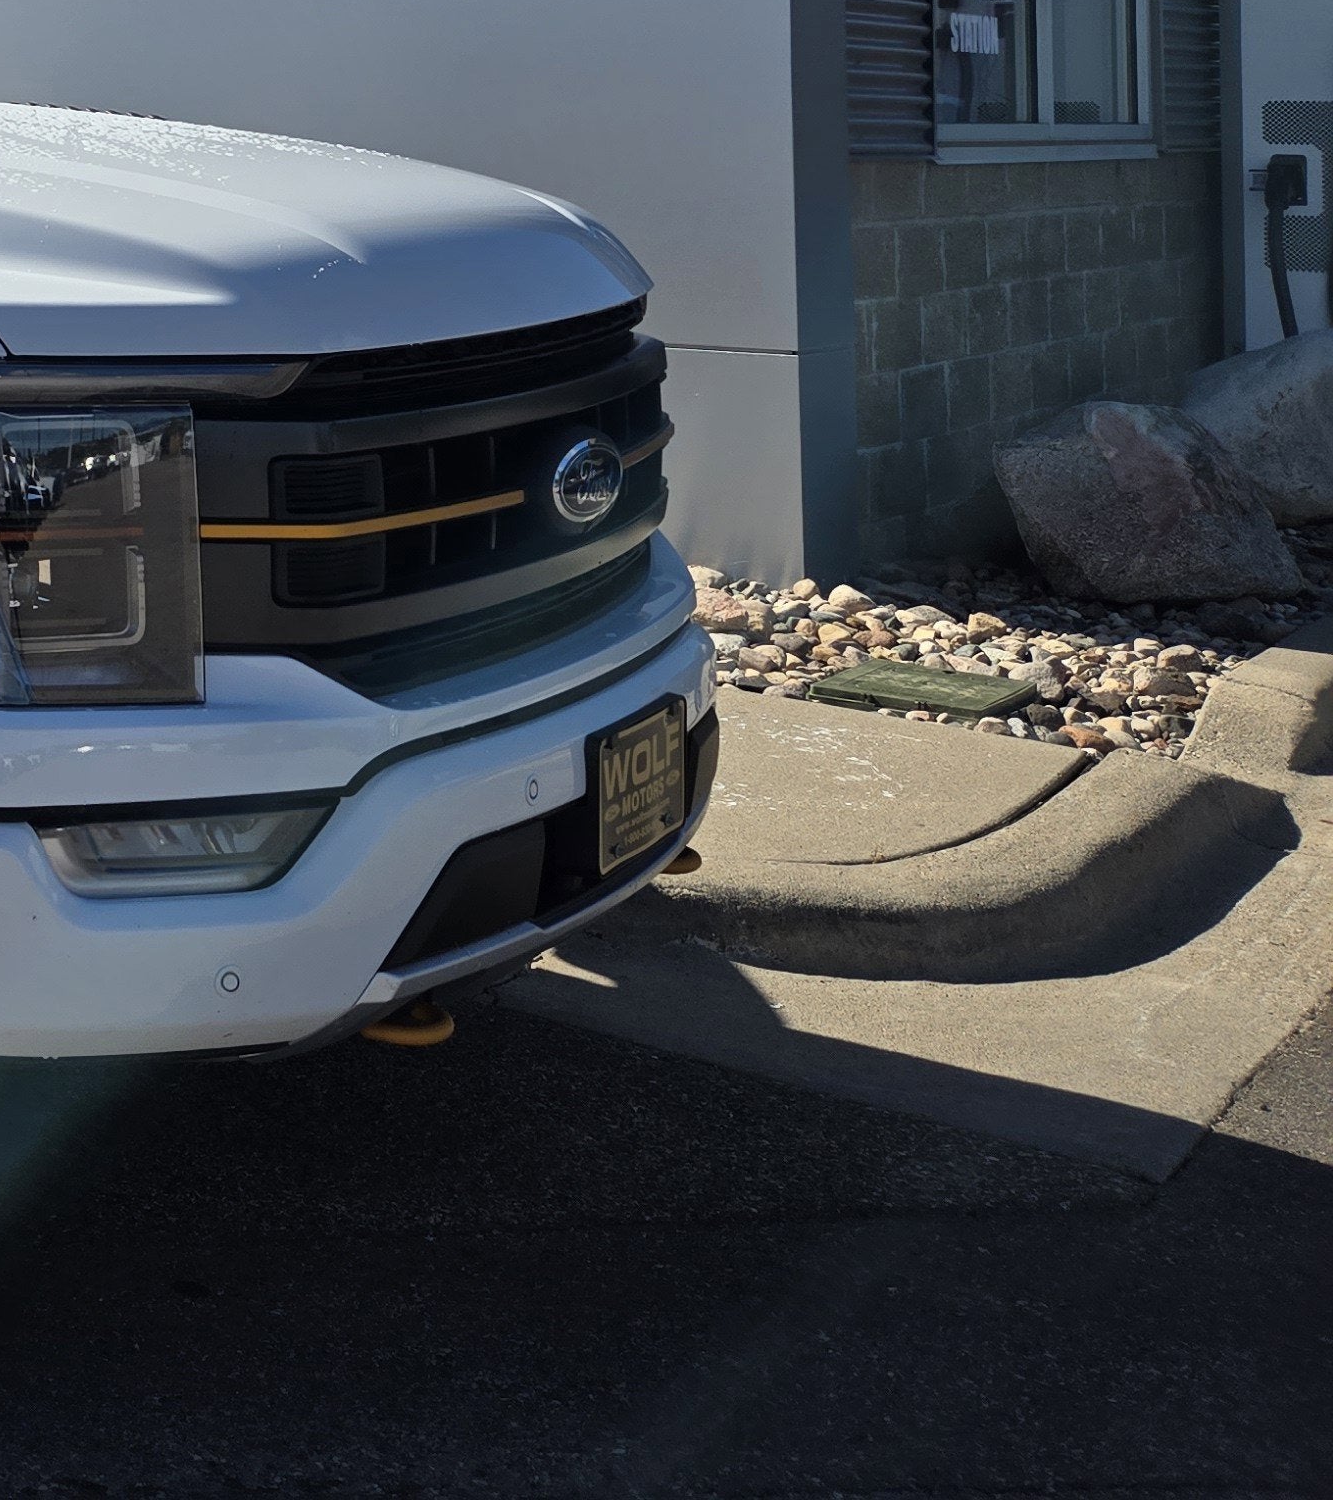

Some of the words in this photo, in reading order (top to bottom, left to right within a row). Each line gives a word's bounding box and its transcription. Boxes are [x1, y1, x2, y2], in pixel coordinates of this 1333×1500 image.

[950, 12, 999, 55] STATION
[603, 721, 681, 800] WOLF
[621, 775, 665, 817] MOTORS
